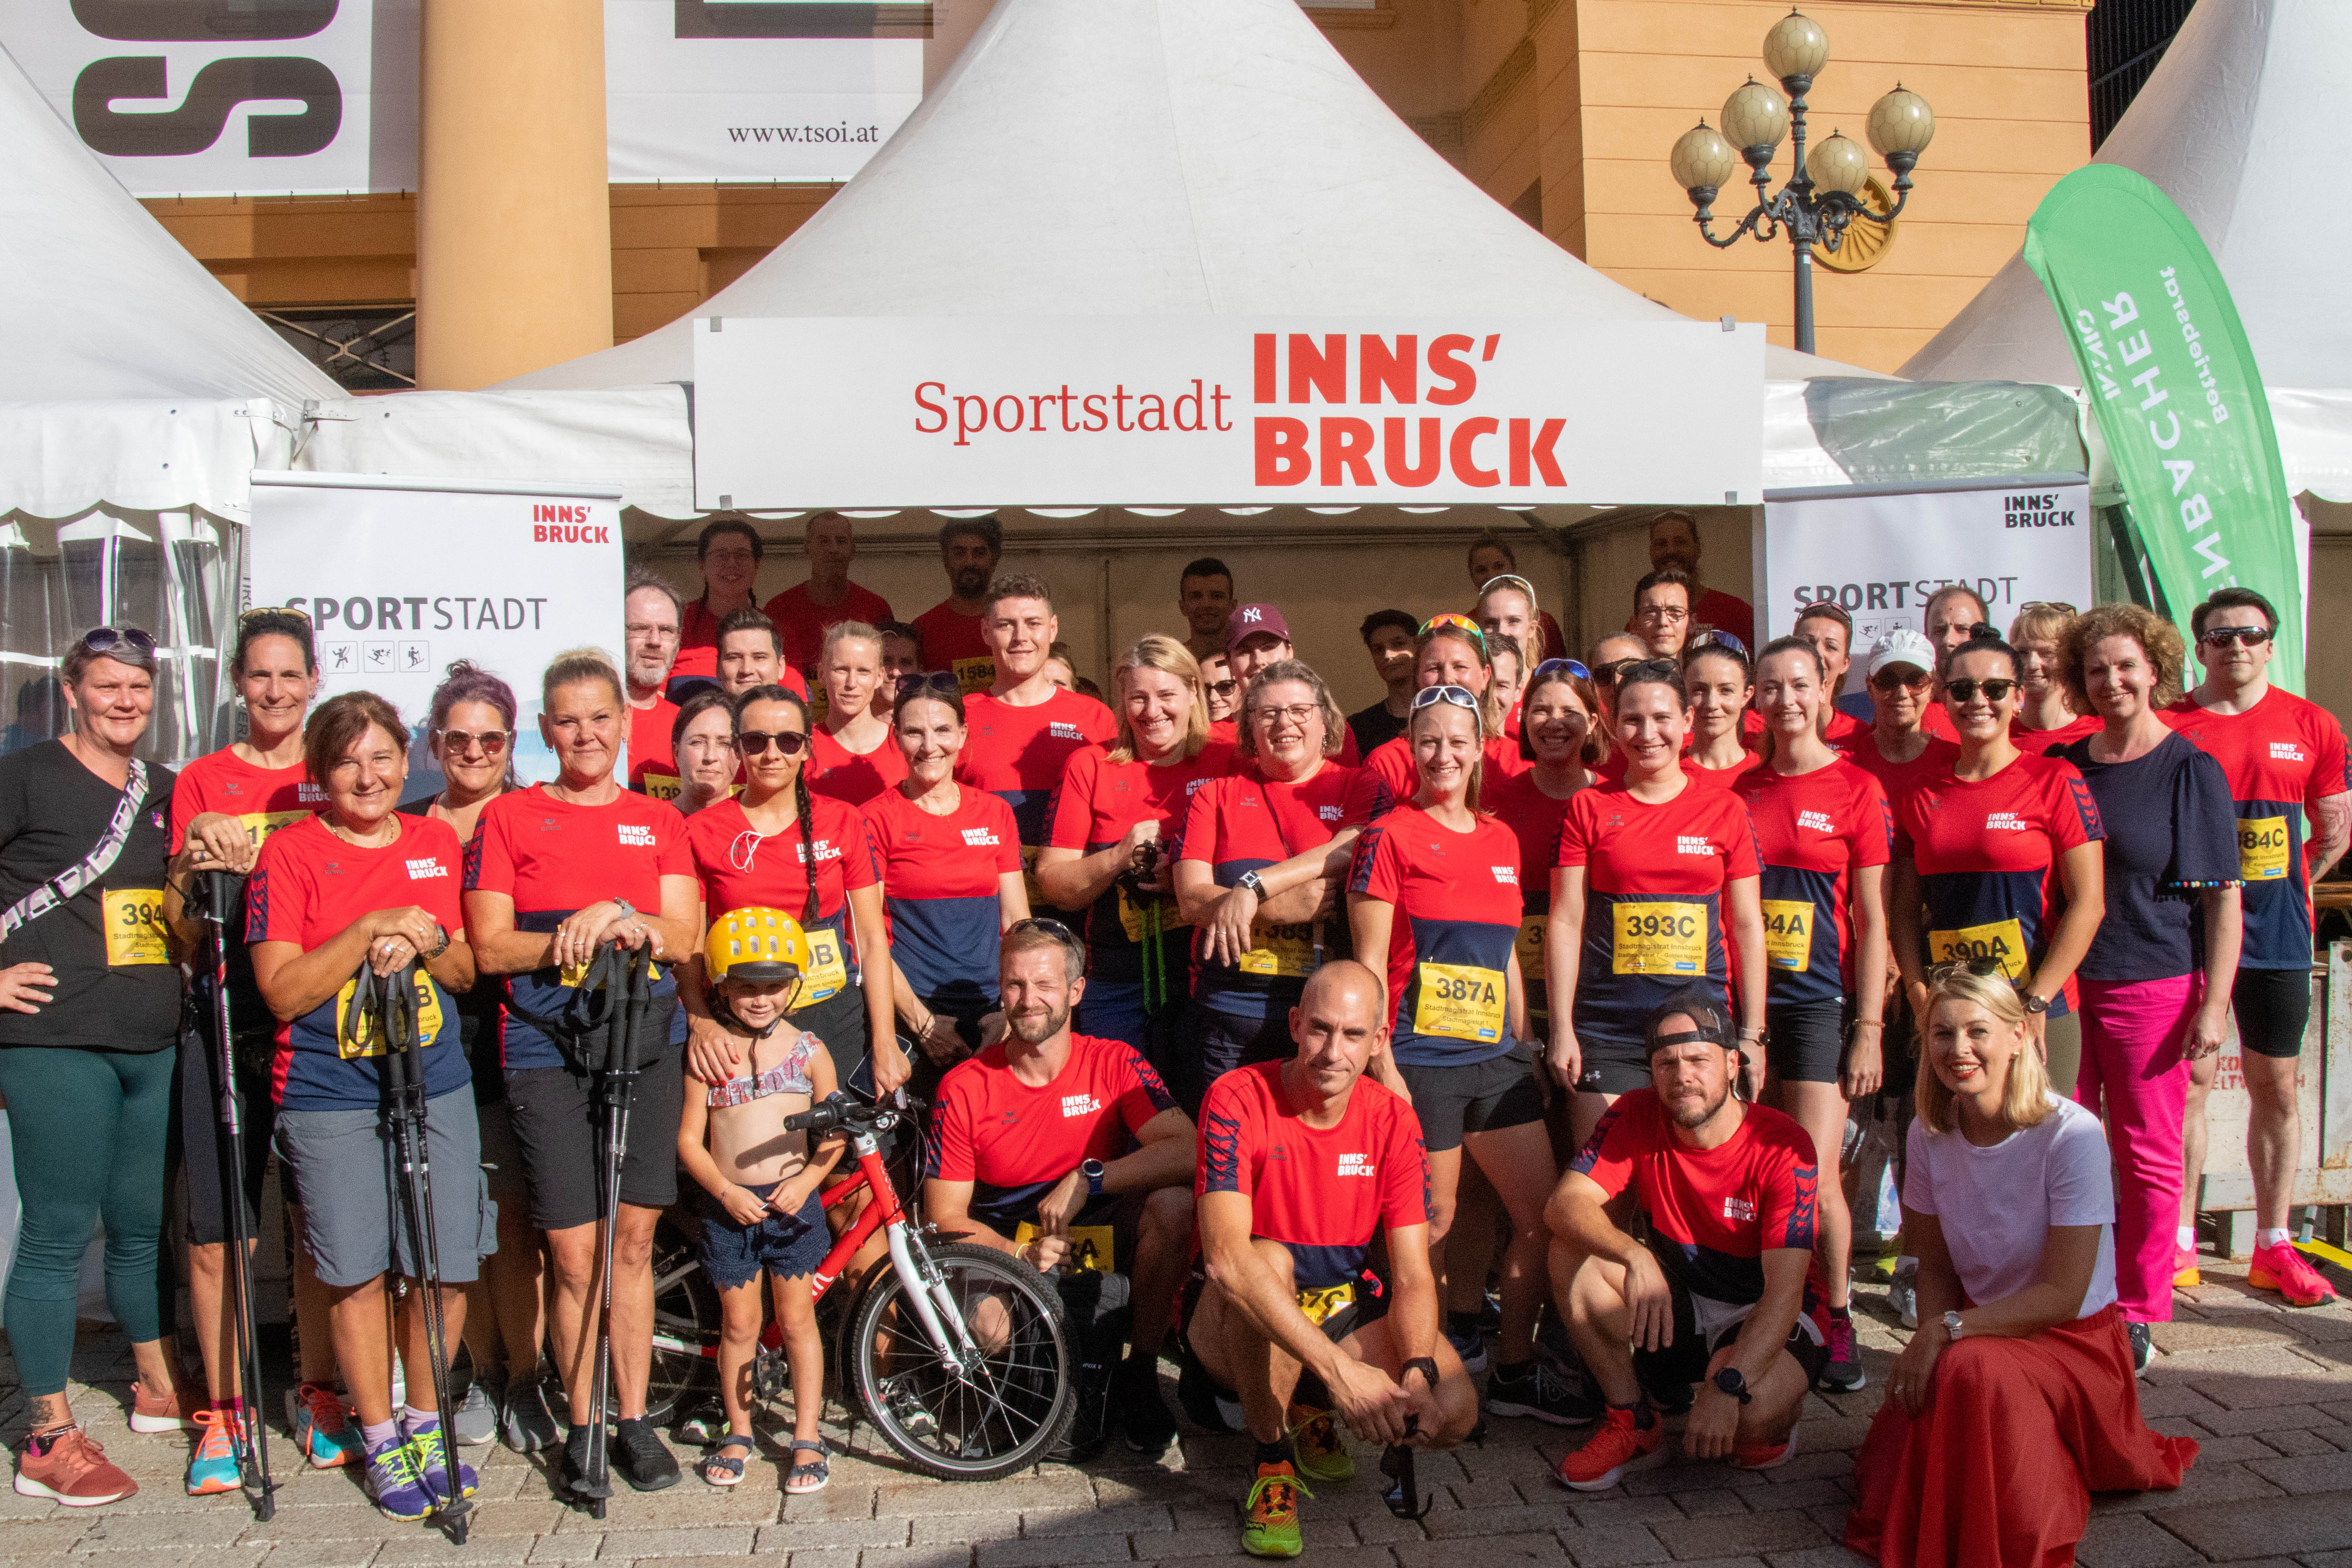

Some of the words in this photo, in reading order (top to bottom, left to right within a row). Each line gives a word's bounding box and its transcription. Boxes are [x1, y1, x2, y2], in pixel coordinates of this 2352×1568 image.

[727, 121, 879, 143] www.tsoi.at
[1254, 333, 1501, 406] INNS'
[914, 379, 1233, 446] Sportstadt
[1254, 416, 1567, 488] BRUCK
[2004, 494, 2059, 511] INNS'
[533, 504, 591, 523] INNS'
[2005, 510, 2075, 528] BRUCK
[534, 525, 609, 544] BRUCK
[1051, 730, 1083, 740] BRUCK
[2270, 742, 2297, 752] INNS'
[2270, 750, 2304, 761] BRUCK
[1800, 810, 1830, 823] INNS'
[618, 824, 651, 836] INNS'
[1797, 818, 1835, 833] BRUCK
[1986, 820, 2026, 830] BRUCK
[961, 827, 989, 838] INNS'
[964, 836, 1000, 846] BRUCK
[1678, 836, 1708, 846] INNS'
[798, 847, 842, 863] BUCK
[1678, 845, 1714, 856] BRUCK
[405, 857, 436, 870] INNS'
[409, 866, 448, 879] BRUCK
[1627, 915, 1695, 938] 393C
[1436, 977, 1496, 1005] 387A
[1424, 1003, 1474, 1015] Stadtmagistrat
[1476, 1010, 1501, 1019] Innsbruck
[1442, 1015, 1485, 1025] Stadtmagistrat
[1063, 1099, 1101, 1117] BRUCK
[1339, 1154, 1368, 1164] INNS'
[1338, 1165, 1375, 1177] BRUCK
